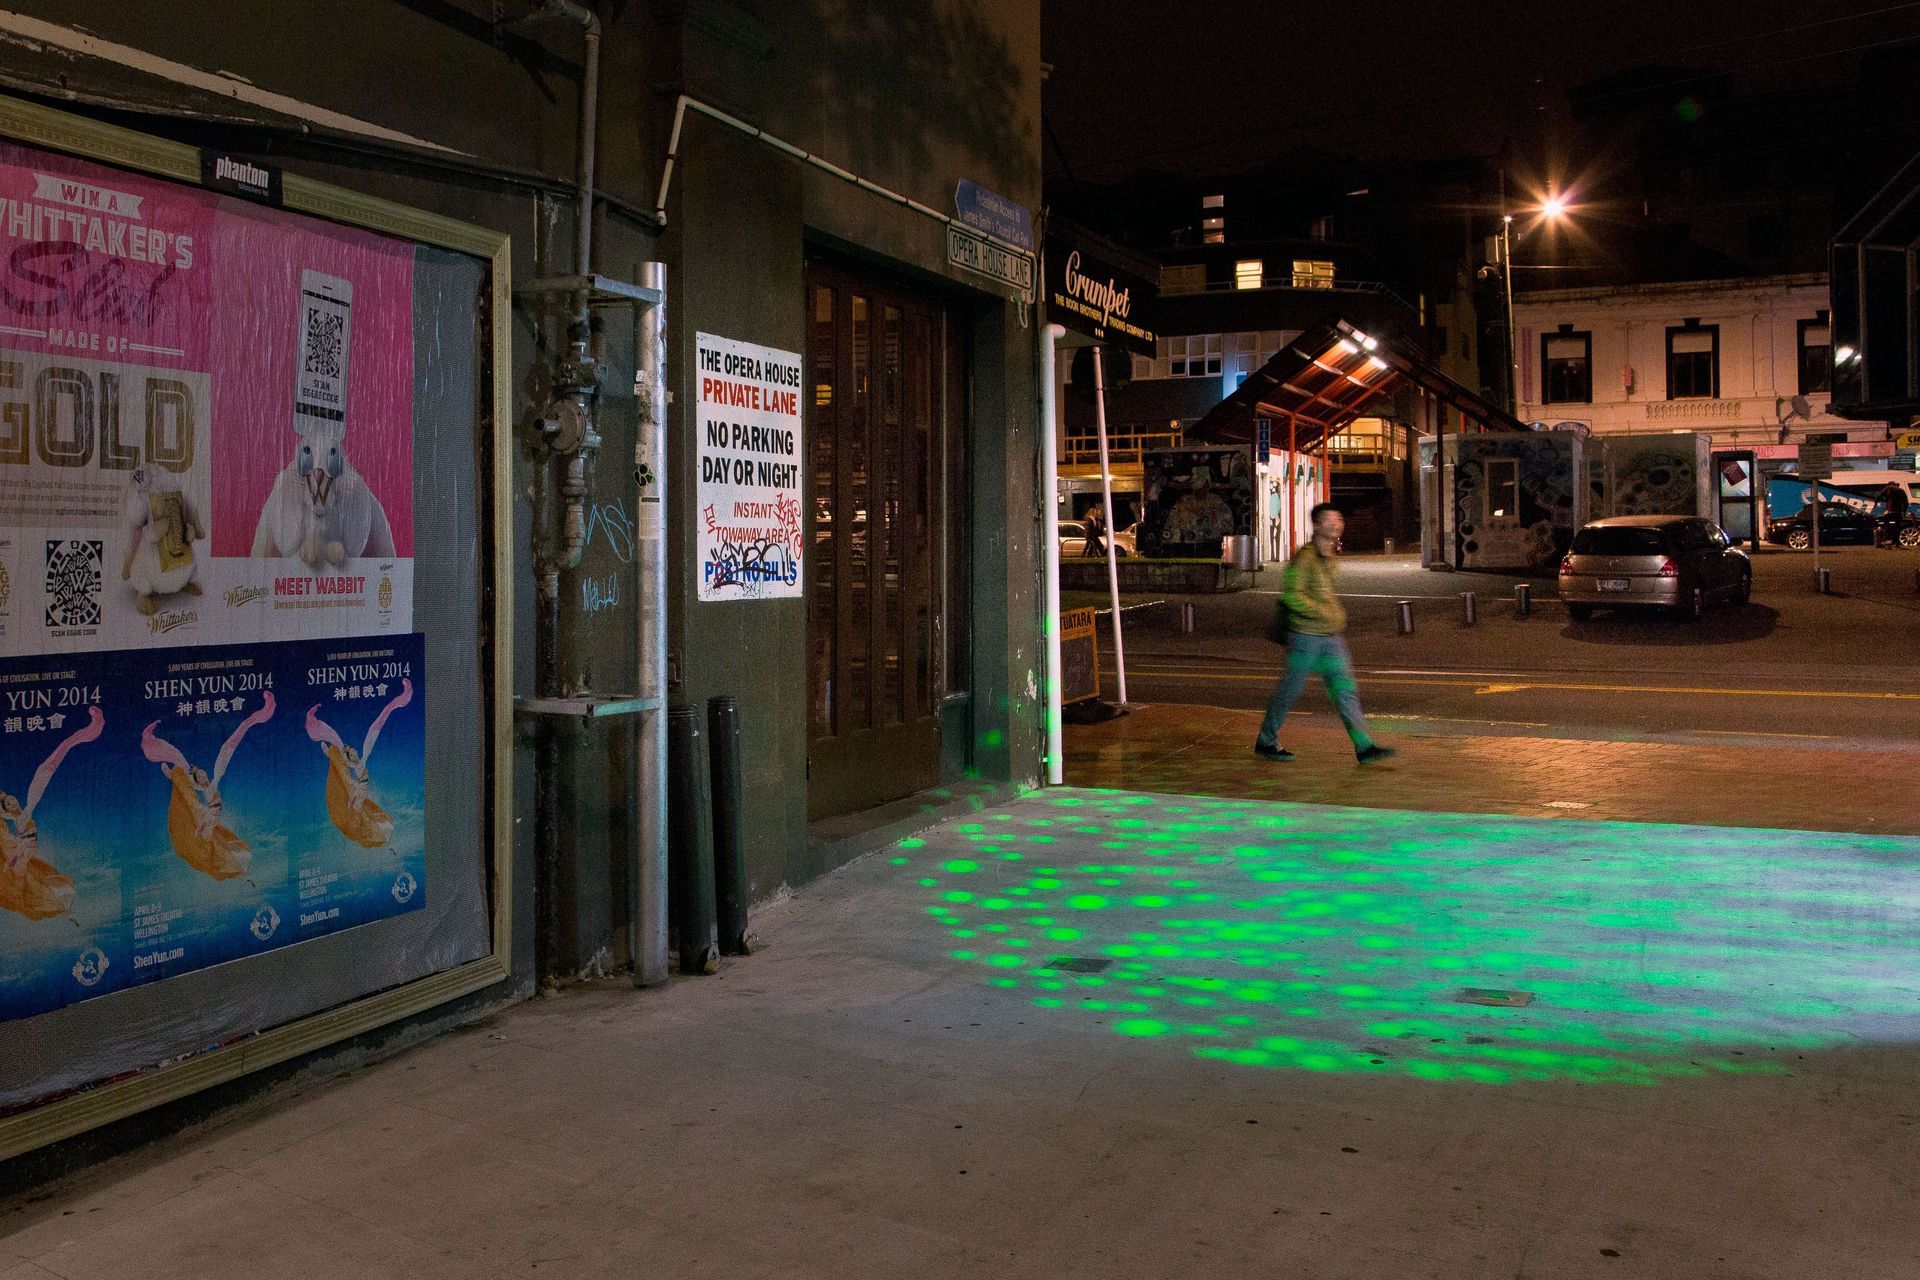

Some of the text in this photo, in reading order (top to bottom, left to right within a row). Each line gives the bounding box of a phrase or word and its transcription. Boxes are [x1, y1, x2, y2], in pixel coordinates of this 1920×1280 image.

[215, 156, 270, 189] phantom
[61, 183, 119, 211] WIN A
[952, 234, 1029, 286] OPERA HOUSE LANE
[1065, 250, 1131, 328] Crumpet
[1055, 292, 1065, 308] THE
[1079, 303, 1102, 323] BROTHERS
[1109, 315, 1126, 333] TRADING
[1126, 323, 1145, 339] COMPANY
[1145, 330, 1153, 342] LTD
[49, 329, 130, 354] MADE OF
[700, 347, 800, 388] THE OPERA HOUSE
[703, 377, 797, 416] PRIVATE LANE
[0, 360, 195, 474] GOLD
[707, 420, 794, 456] NO PARKING
[702, 455, 798, 489] DAY OR NIGHT
[733, 501, 773, 519] INSTANT
[715, 526, 791, 544] TOWAWAY AREA
[704, 560, 741, 583] POST
[742, 561, 760, 582] NO
[763, 560, 798, 582] BILLS
[274, 576, 366, 596] MEET WABBIT
[51, 630, 65, 638] SCAN
[84, 628, 98, 637] CODE
[144, 671, 273, 700] SHEN YUN 2014
[307, 661, 411, 686] SHEN YUN 2014
[5, 684, 102, 712] YUN 2014
[332, 682, 389, 702] 神韻晚會
[175, 695, 246, 717] 神韻晚會
[134, 904, 151, 917] APRIL
[134, 908, 183, 929] ST JAMES THEATRE
[300, 907, 340, 927] ShenYun.com
[134, 923, 169, 940] WELLINGTON
[133, 946, 185, 969] ShenYun.com
